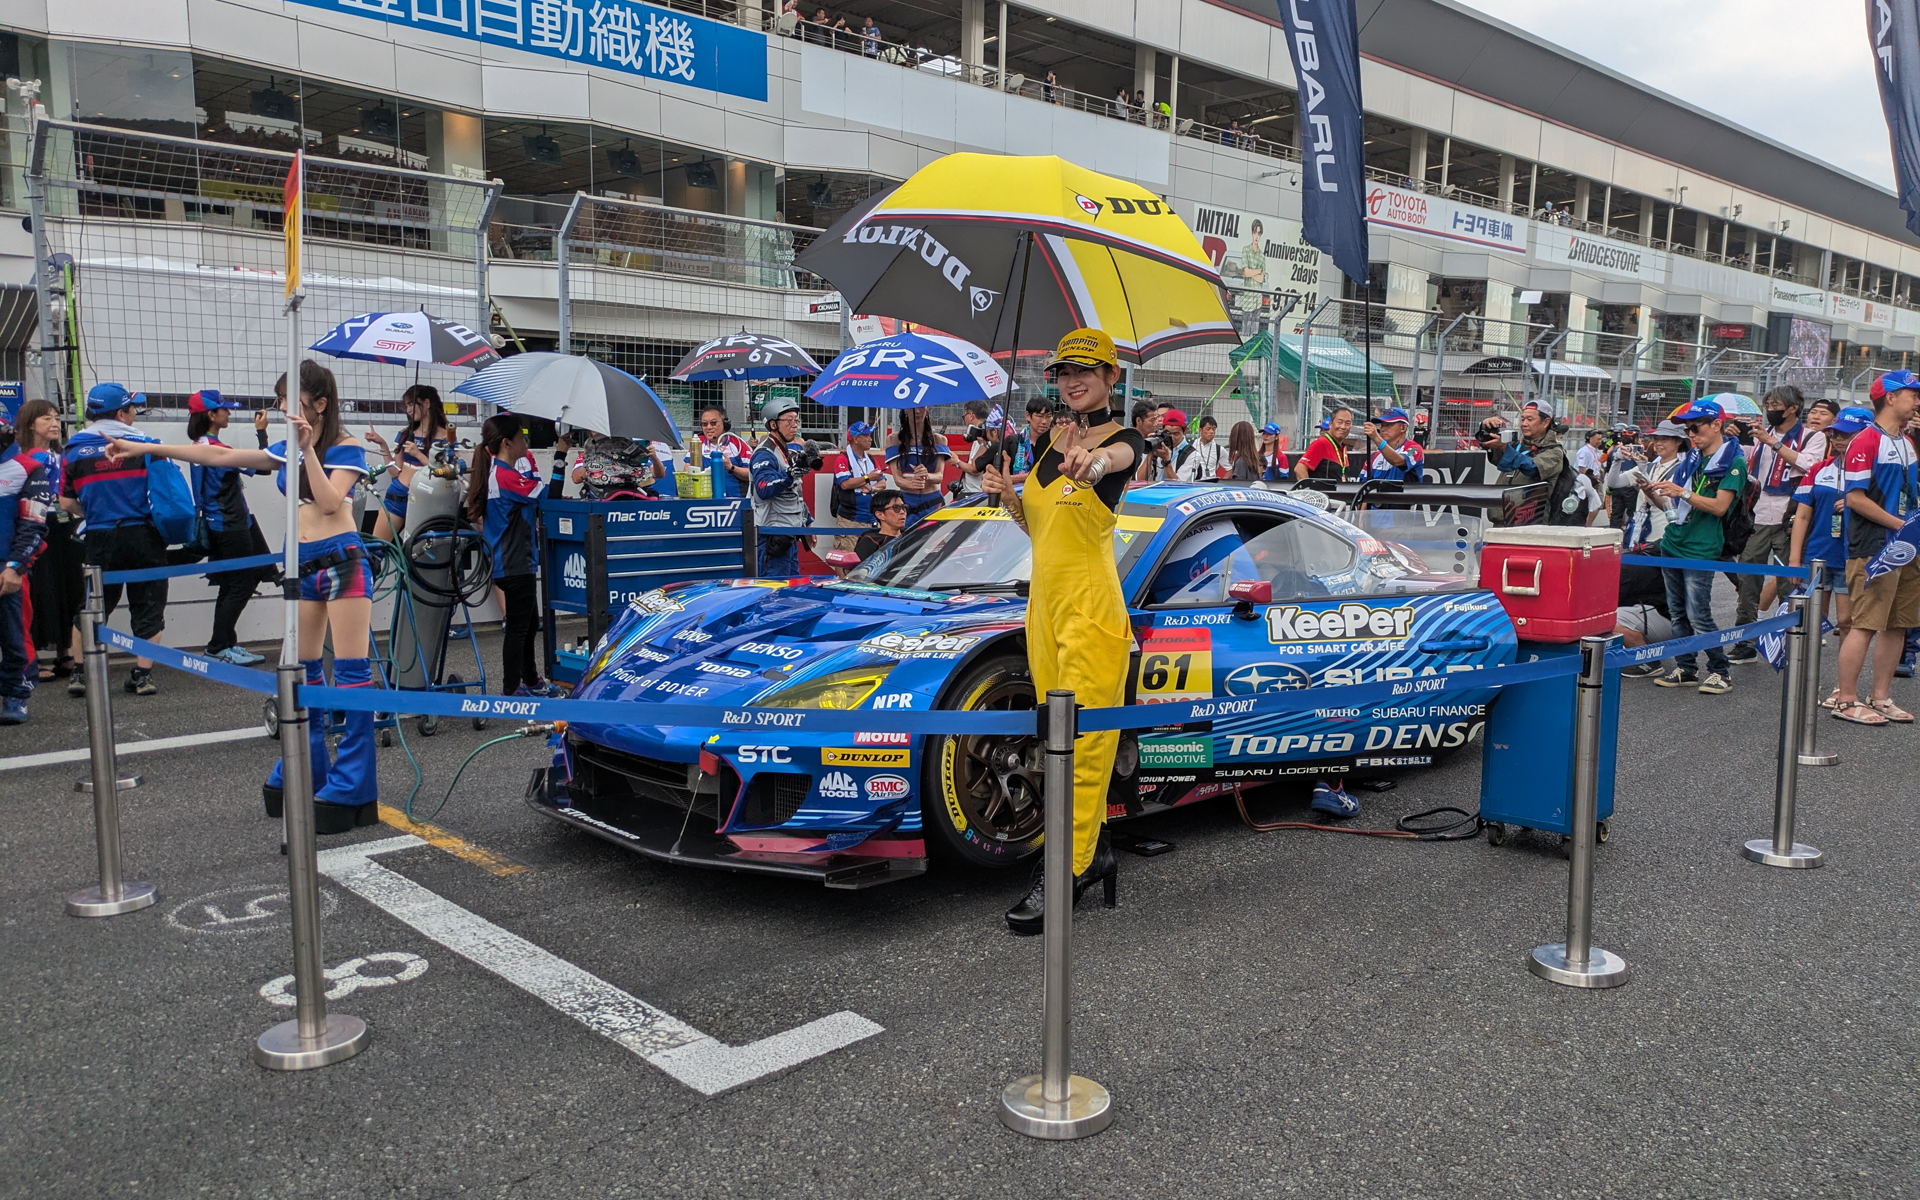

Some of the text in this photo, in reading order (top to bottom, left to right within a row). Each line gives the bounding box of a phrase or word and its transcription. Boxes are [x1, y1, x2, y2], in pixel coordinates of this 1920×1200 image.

[1388, 191, 1428, 214] TOYOTA
[1196, 207, 1240, 238] INITIAL
[1386, 208, 1428, 226] AUTO BODY
[1452, 210, 1514, 242] トヨタ車体
[1263, 239, 1320, 267] Anniversary
[1567, 236, 1641, 274] BRIDGESTONE
[1290, 263, 1319, 285] 2days
[1773, 287, 1799, 302] Panasonic
[695, 335, 794, 358] BRZ
[852, 341, 902, 351] SUBARU
[1060, 345, 1095, 354] DUNLOP
[473, 353, 491, 365] Proud
[748, 348, 773, 365] 61
[834, 348, 964, 387] BRZ
[852, 379, 879, 387] BOXER
[893, 377, 930, 405] 61
[587, 462, 603, 471] Arai
[1190, 492, 1230, 508] T.IGUCHI
[1245, 491, 1300, 507] H.YAMAUCHI
[607, 509, 672, 523] Mac Tools
[1359, 540, 1388, 553] MOTUL
[1453, 603, 1488, 612] Fujikura
[1164, 613, 1235, 626] R&D SPORT
[1268, 604, 1412, 642] KeePer
[112, 632, 134, 651] R&D SPORT
[672, 629, 713, 643] DENSO
[1144, 635, 1207, 644] AUTOBACS
[1719, 628, 1745, 643] R&D SPORT
[737, 642, 804, 660] DENSO
[856, 646, 876, 654] FOR
[877, 649, 909, 660] SMART
[933, 652, 957, 660] LIFE
[1279, 642, 1405, 655] FOR SMART CAR LIFE
[1634, 645, 1664, 661] R&D SPORT
[182, 655, 208, 674] R&D SPORT
[1142, 653, 1192, 691] 61
[609, 667, 709, 698] Proud of BOXER
[1391, 677, 1448, 696] R&D SPORT
[461, 698, 541, 716] R&D SPORT
[872, 692, 914, 710] NPR
[1190, 703, 1215, 718] R&D
[1217, 698, 1257, 716] SPORT
[722, 710, 806, 727] R&D SPORT
[1314, 704, 1486, 719] MIZUHO SUBARU FINANCE
[856, 731, 908, 744] MOTUL
[738, 745, 792, 764] STC
[838, 753, 904, 763] DUNLOP
[1138, 754, 1206, 765] UTOMOTIVE
[1355, 757, 1396, 767] FBK
[1166, 775, 1197, 783] POWER
[1215, 765, 1350, 777] SUBARU LOGISTICS
[819, 771, 858, 792] MAC
[870, 780, 904, 792] BMC
[944, 744, 961, 823] DUNLOP
[819, 790, 859, 799] TOOLS
[871, 791, 886, 799] Air
